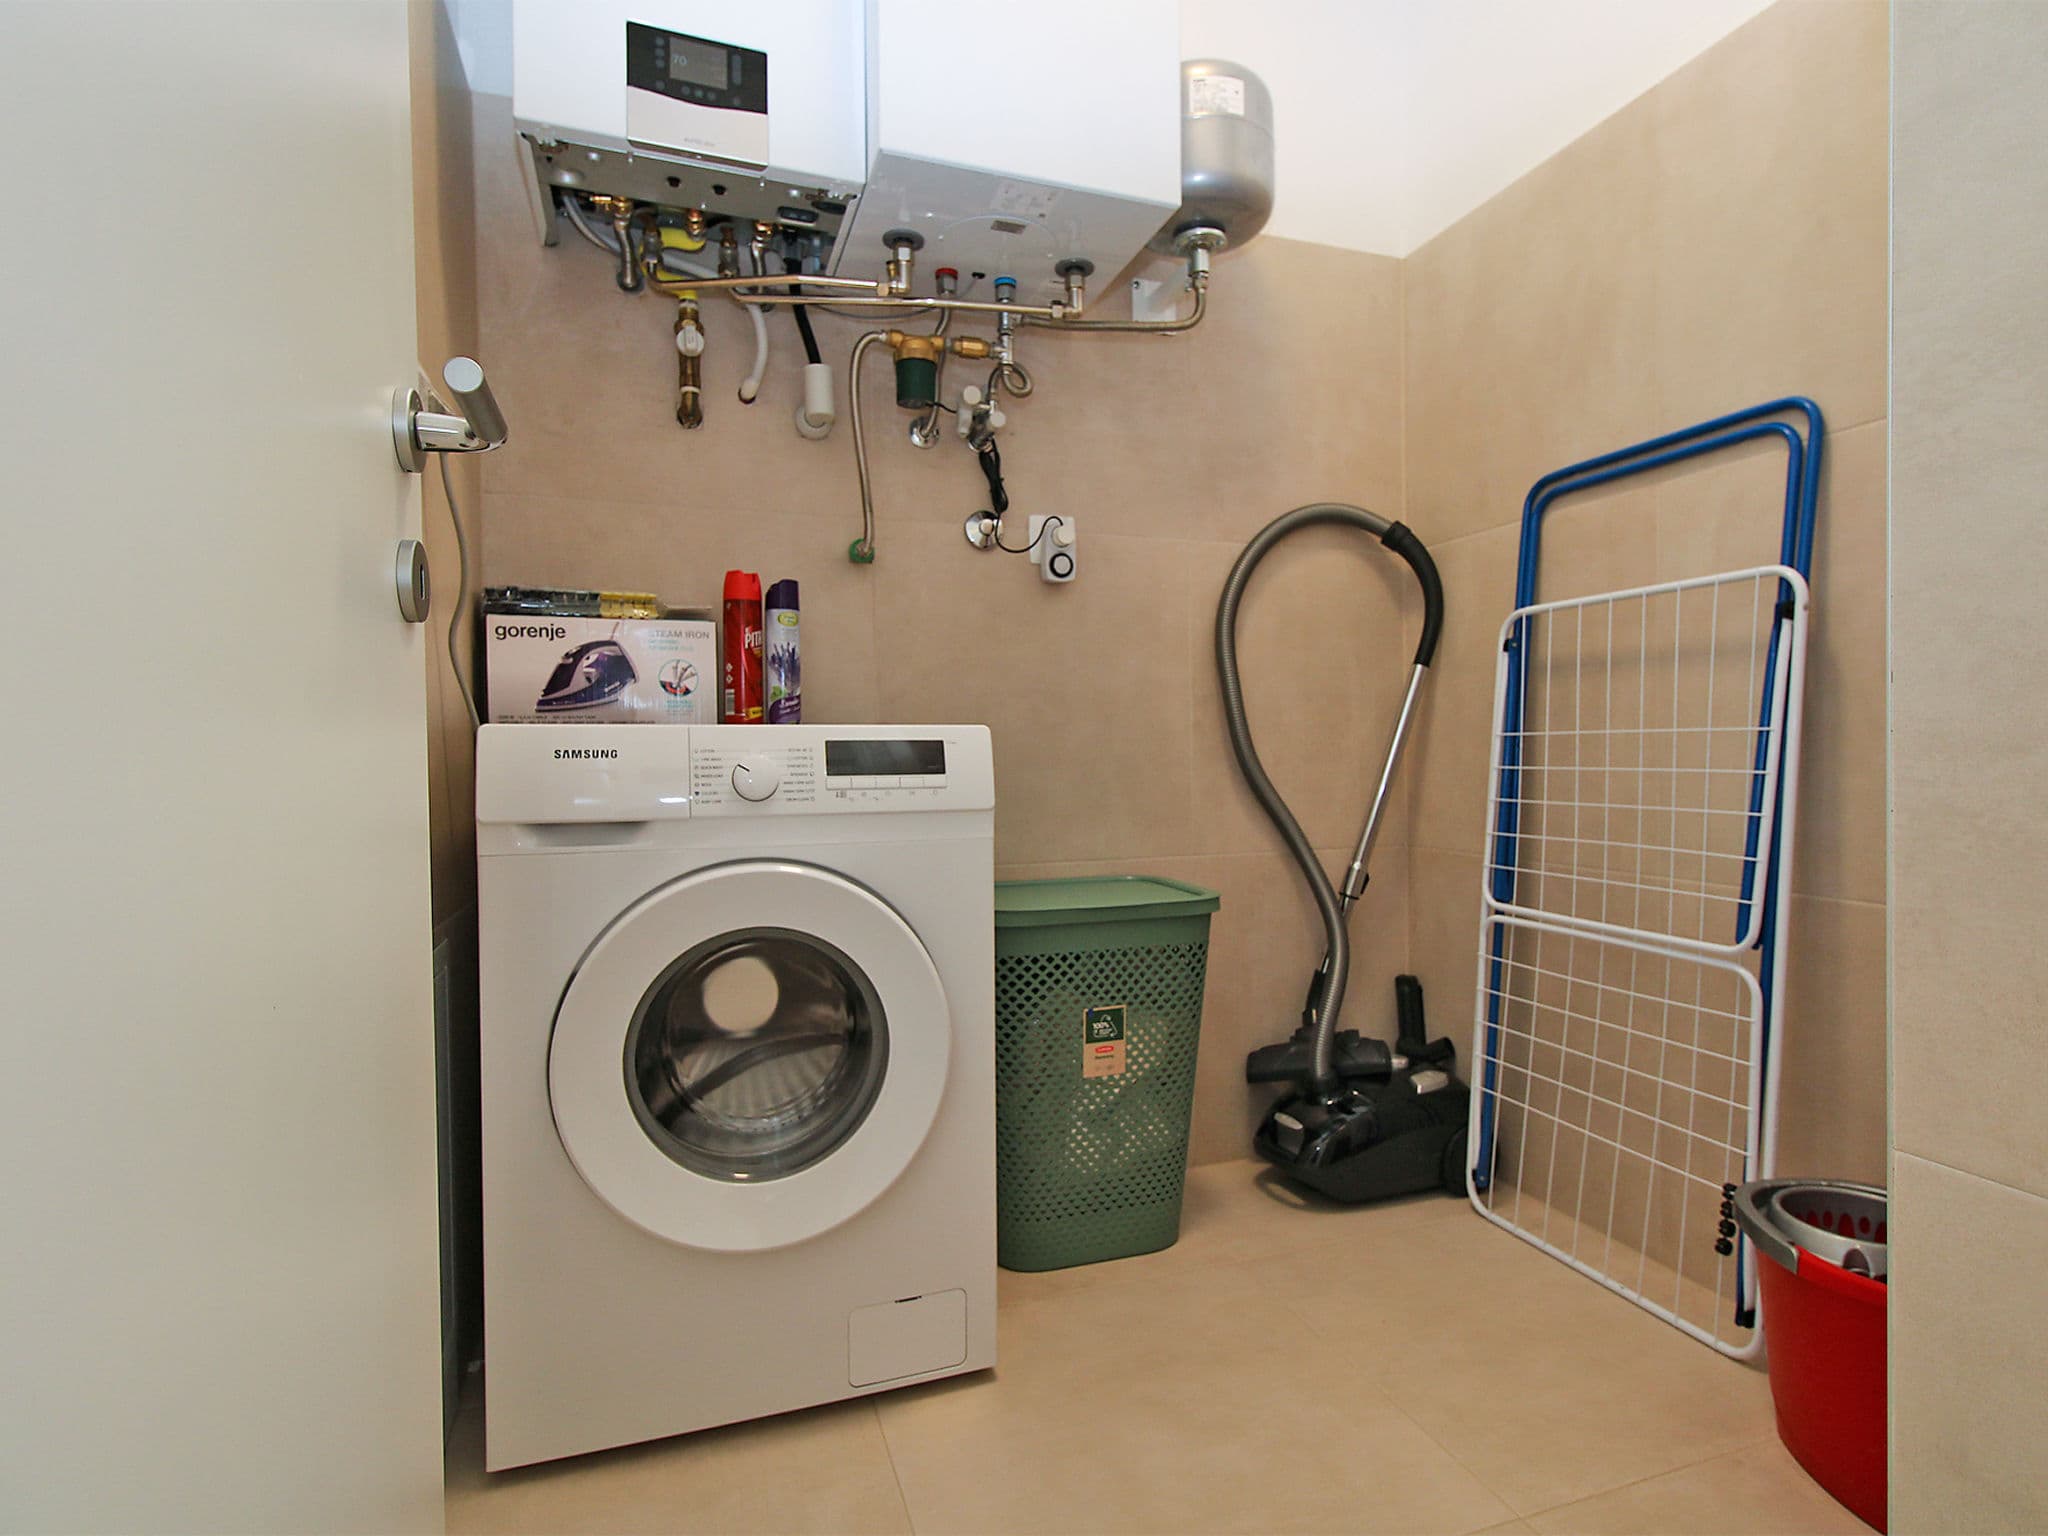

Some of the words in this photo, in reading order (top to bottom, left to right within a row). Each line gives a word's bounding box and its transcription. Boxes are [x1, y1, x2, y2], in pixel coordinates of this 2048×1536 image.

[494, 624, 566, 640] gorenje
[684, 631, 710, 640] IRON
[554, 748, 618, 760] SAMSUNG
